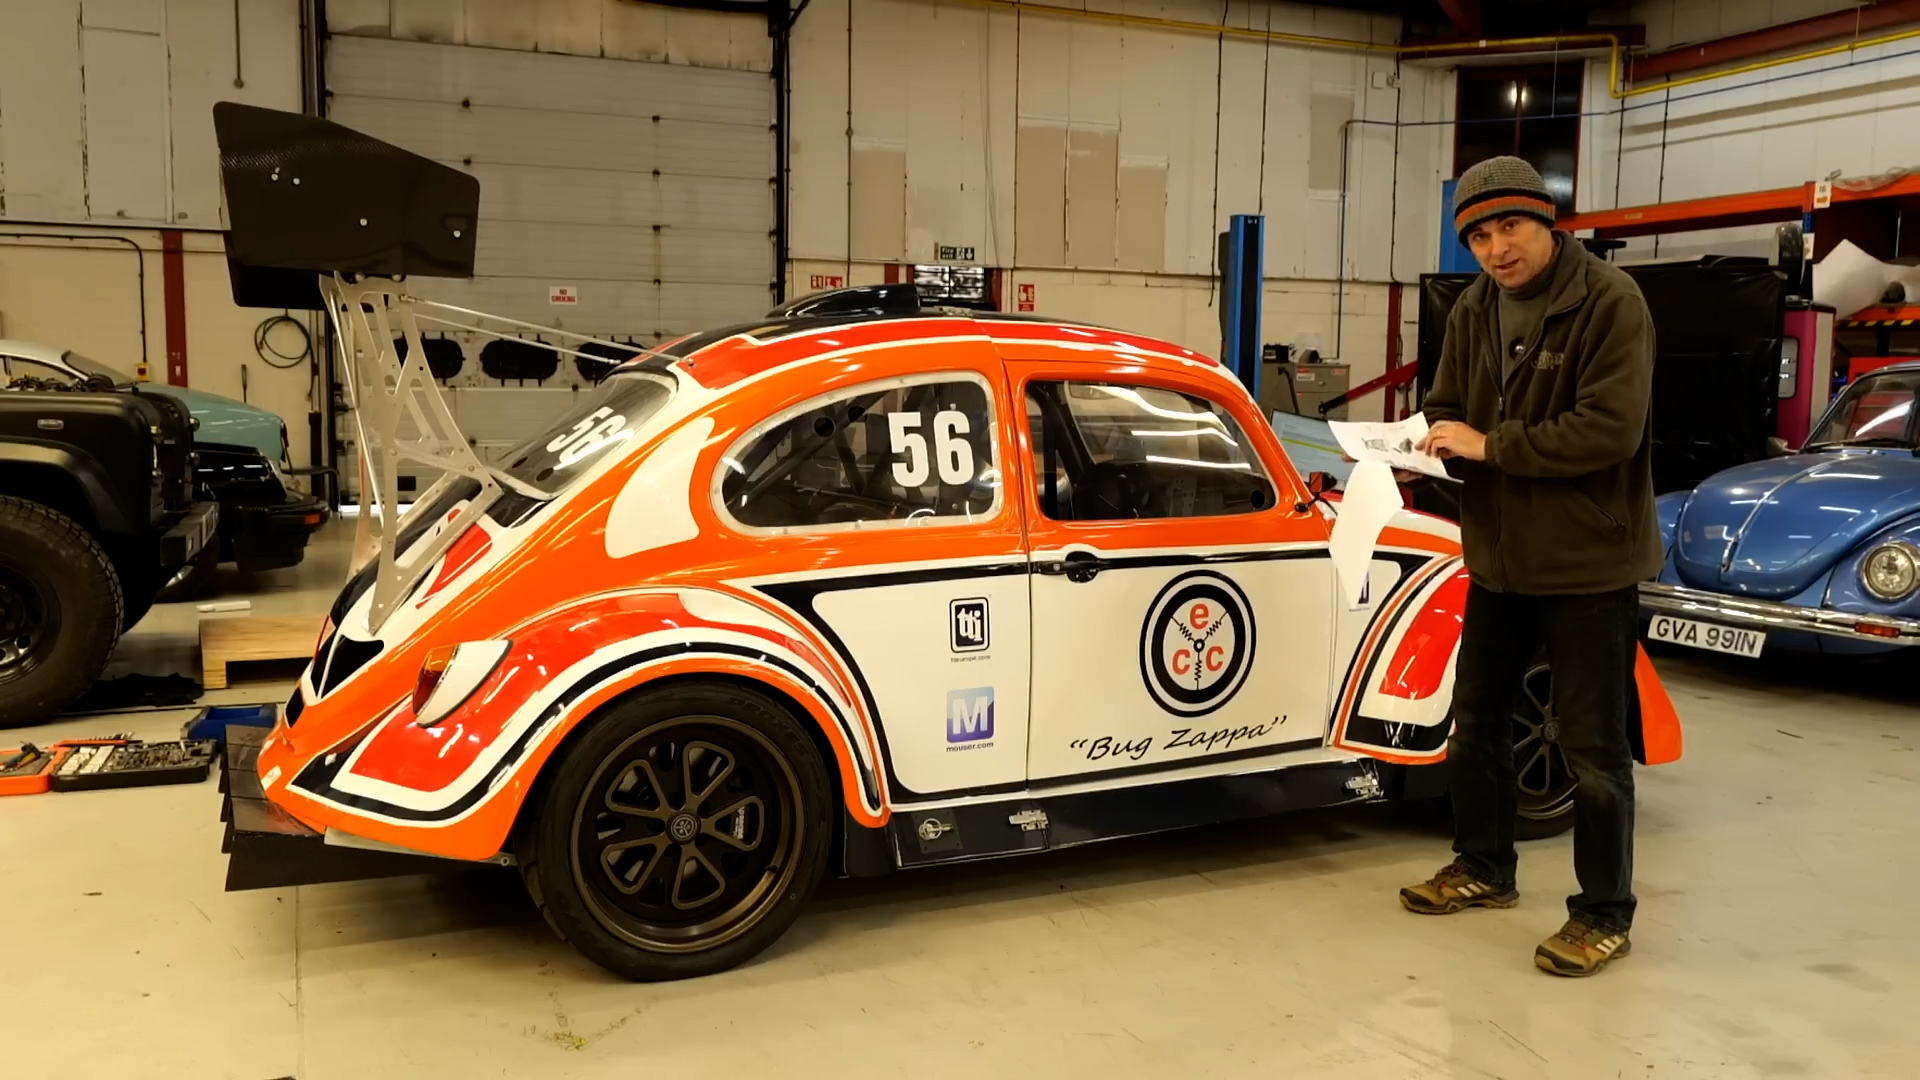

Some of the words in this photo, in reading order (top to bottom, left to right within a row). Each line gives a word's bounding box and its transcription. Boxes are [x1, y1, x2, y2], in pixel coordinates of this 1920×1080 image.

[546, 406, 629, 470] 56
[888, 410, 974, 487] 56
[1656, 618, 1698, 644] GVA
[952, 696, 988, 735] M
[946, 743, 994, 752] mouser.com
